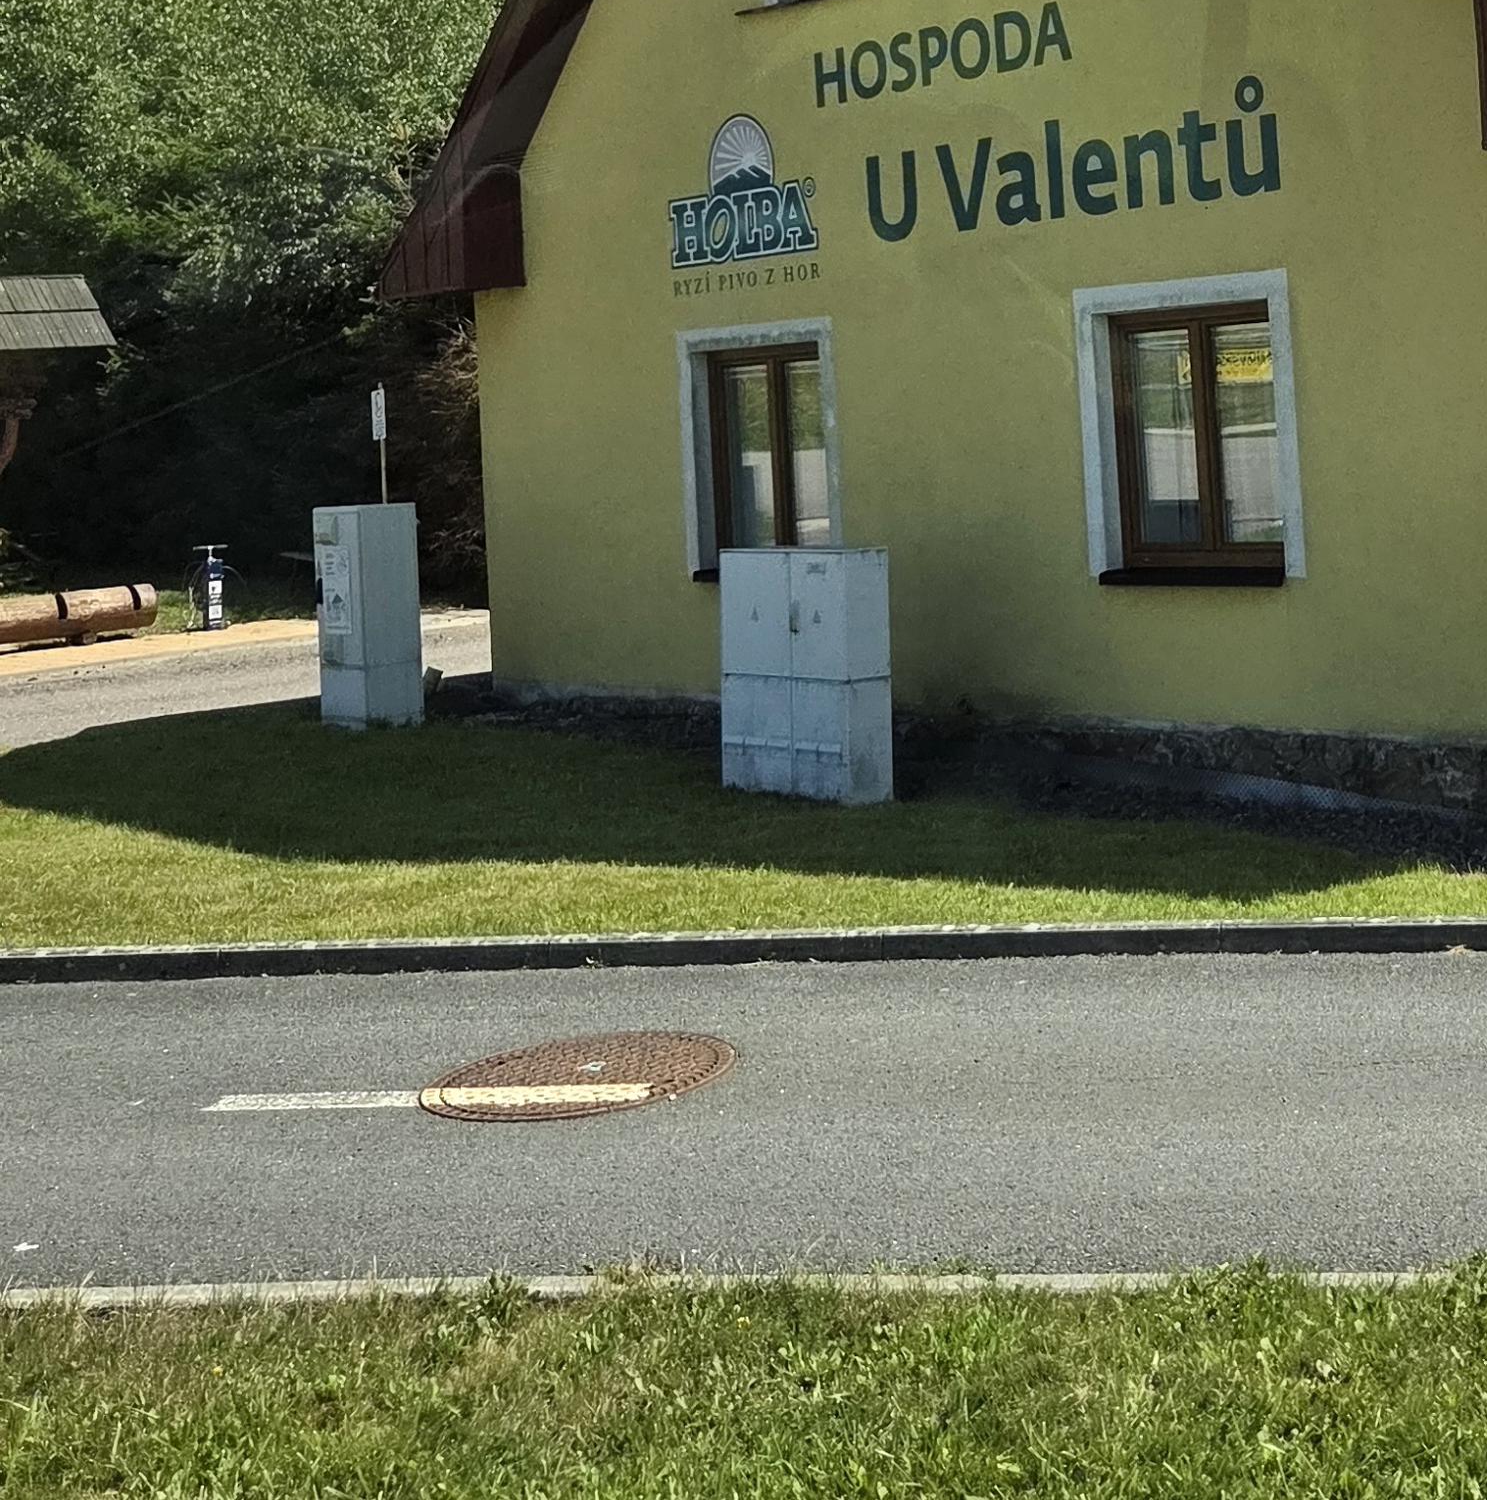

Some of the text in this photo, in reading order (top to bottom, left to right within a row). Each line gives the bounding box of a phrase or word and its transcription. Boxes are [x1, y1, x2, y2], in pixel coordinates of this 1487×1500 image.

[814, 1, 1072, 108] HOSPODA
[866, 75, 1281, 241] U Valentů
[668, 179, 819, 269] HOLBA
[673, 263, 820, 297] RYZÍ PIVO Z HOR
